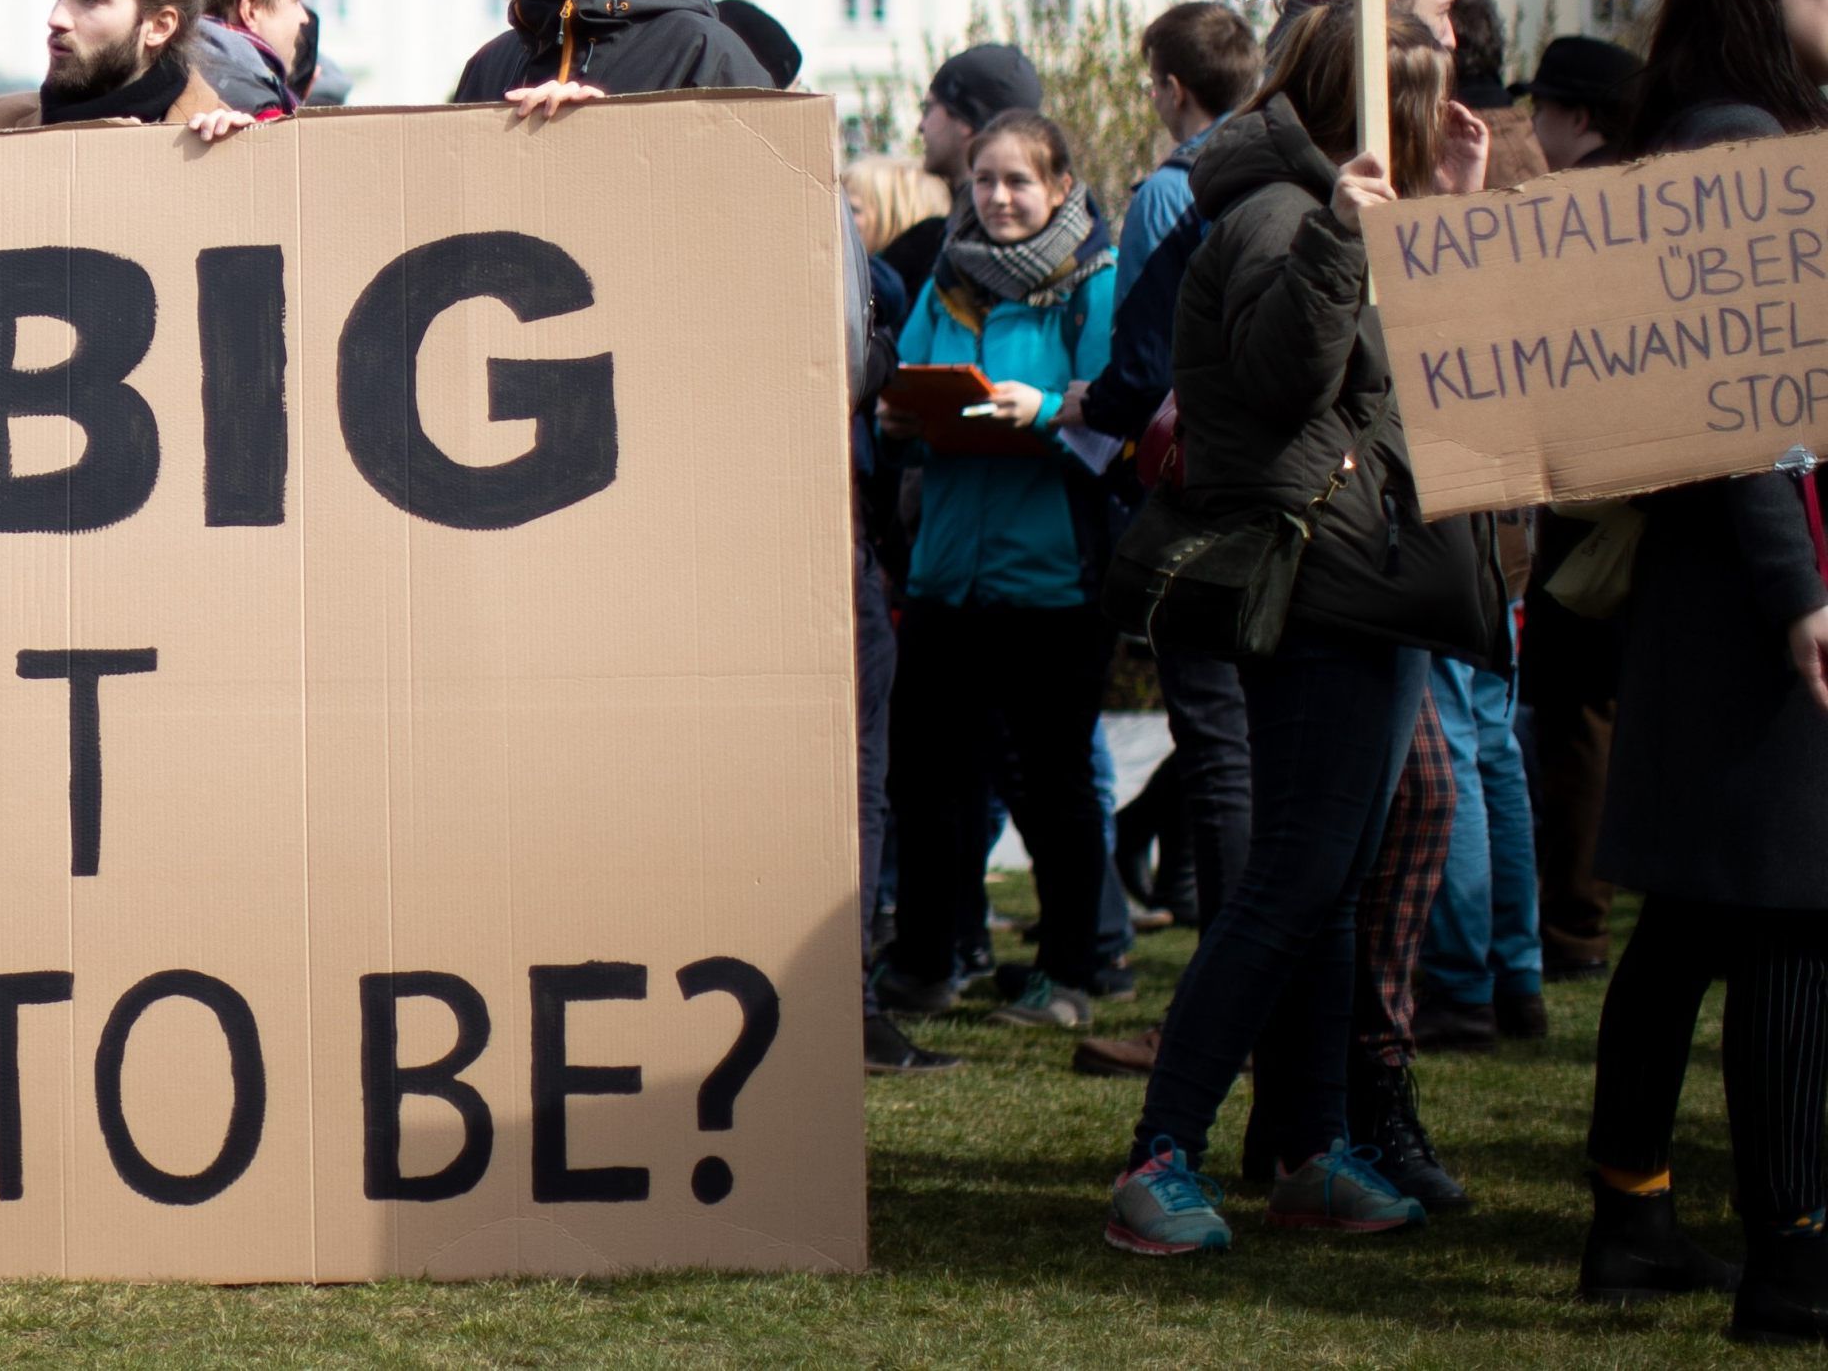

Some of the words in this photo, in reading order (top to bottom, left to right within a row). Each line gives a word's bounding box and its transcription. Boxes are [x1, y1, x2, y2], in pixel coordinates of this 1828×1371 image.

[1395, 165, 1817, 280] KAPITALISMUS
[1657, 228, 1827, 303] ÜBER
[1420, 300, 1828, 410] KLIMAWANDEL
[1706, 368, 1828, 433] STOP
[361, 955, 781, 1207] BE?
